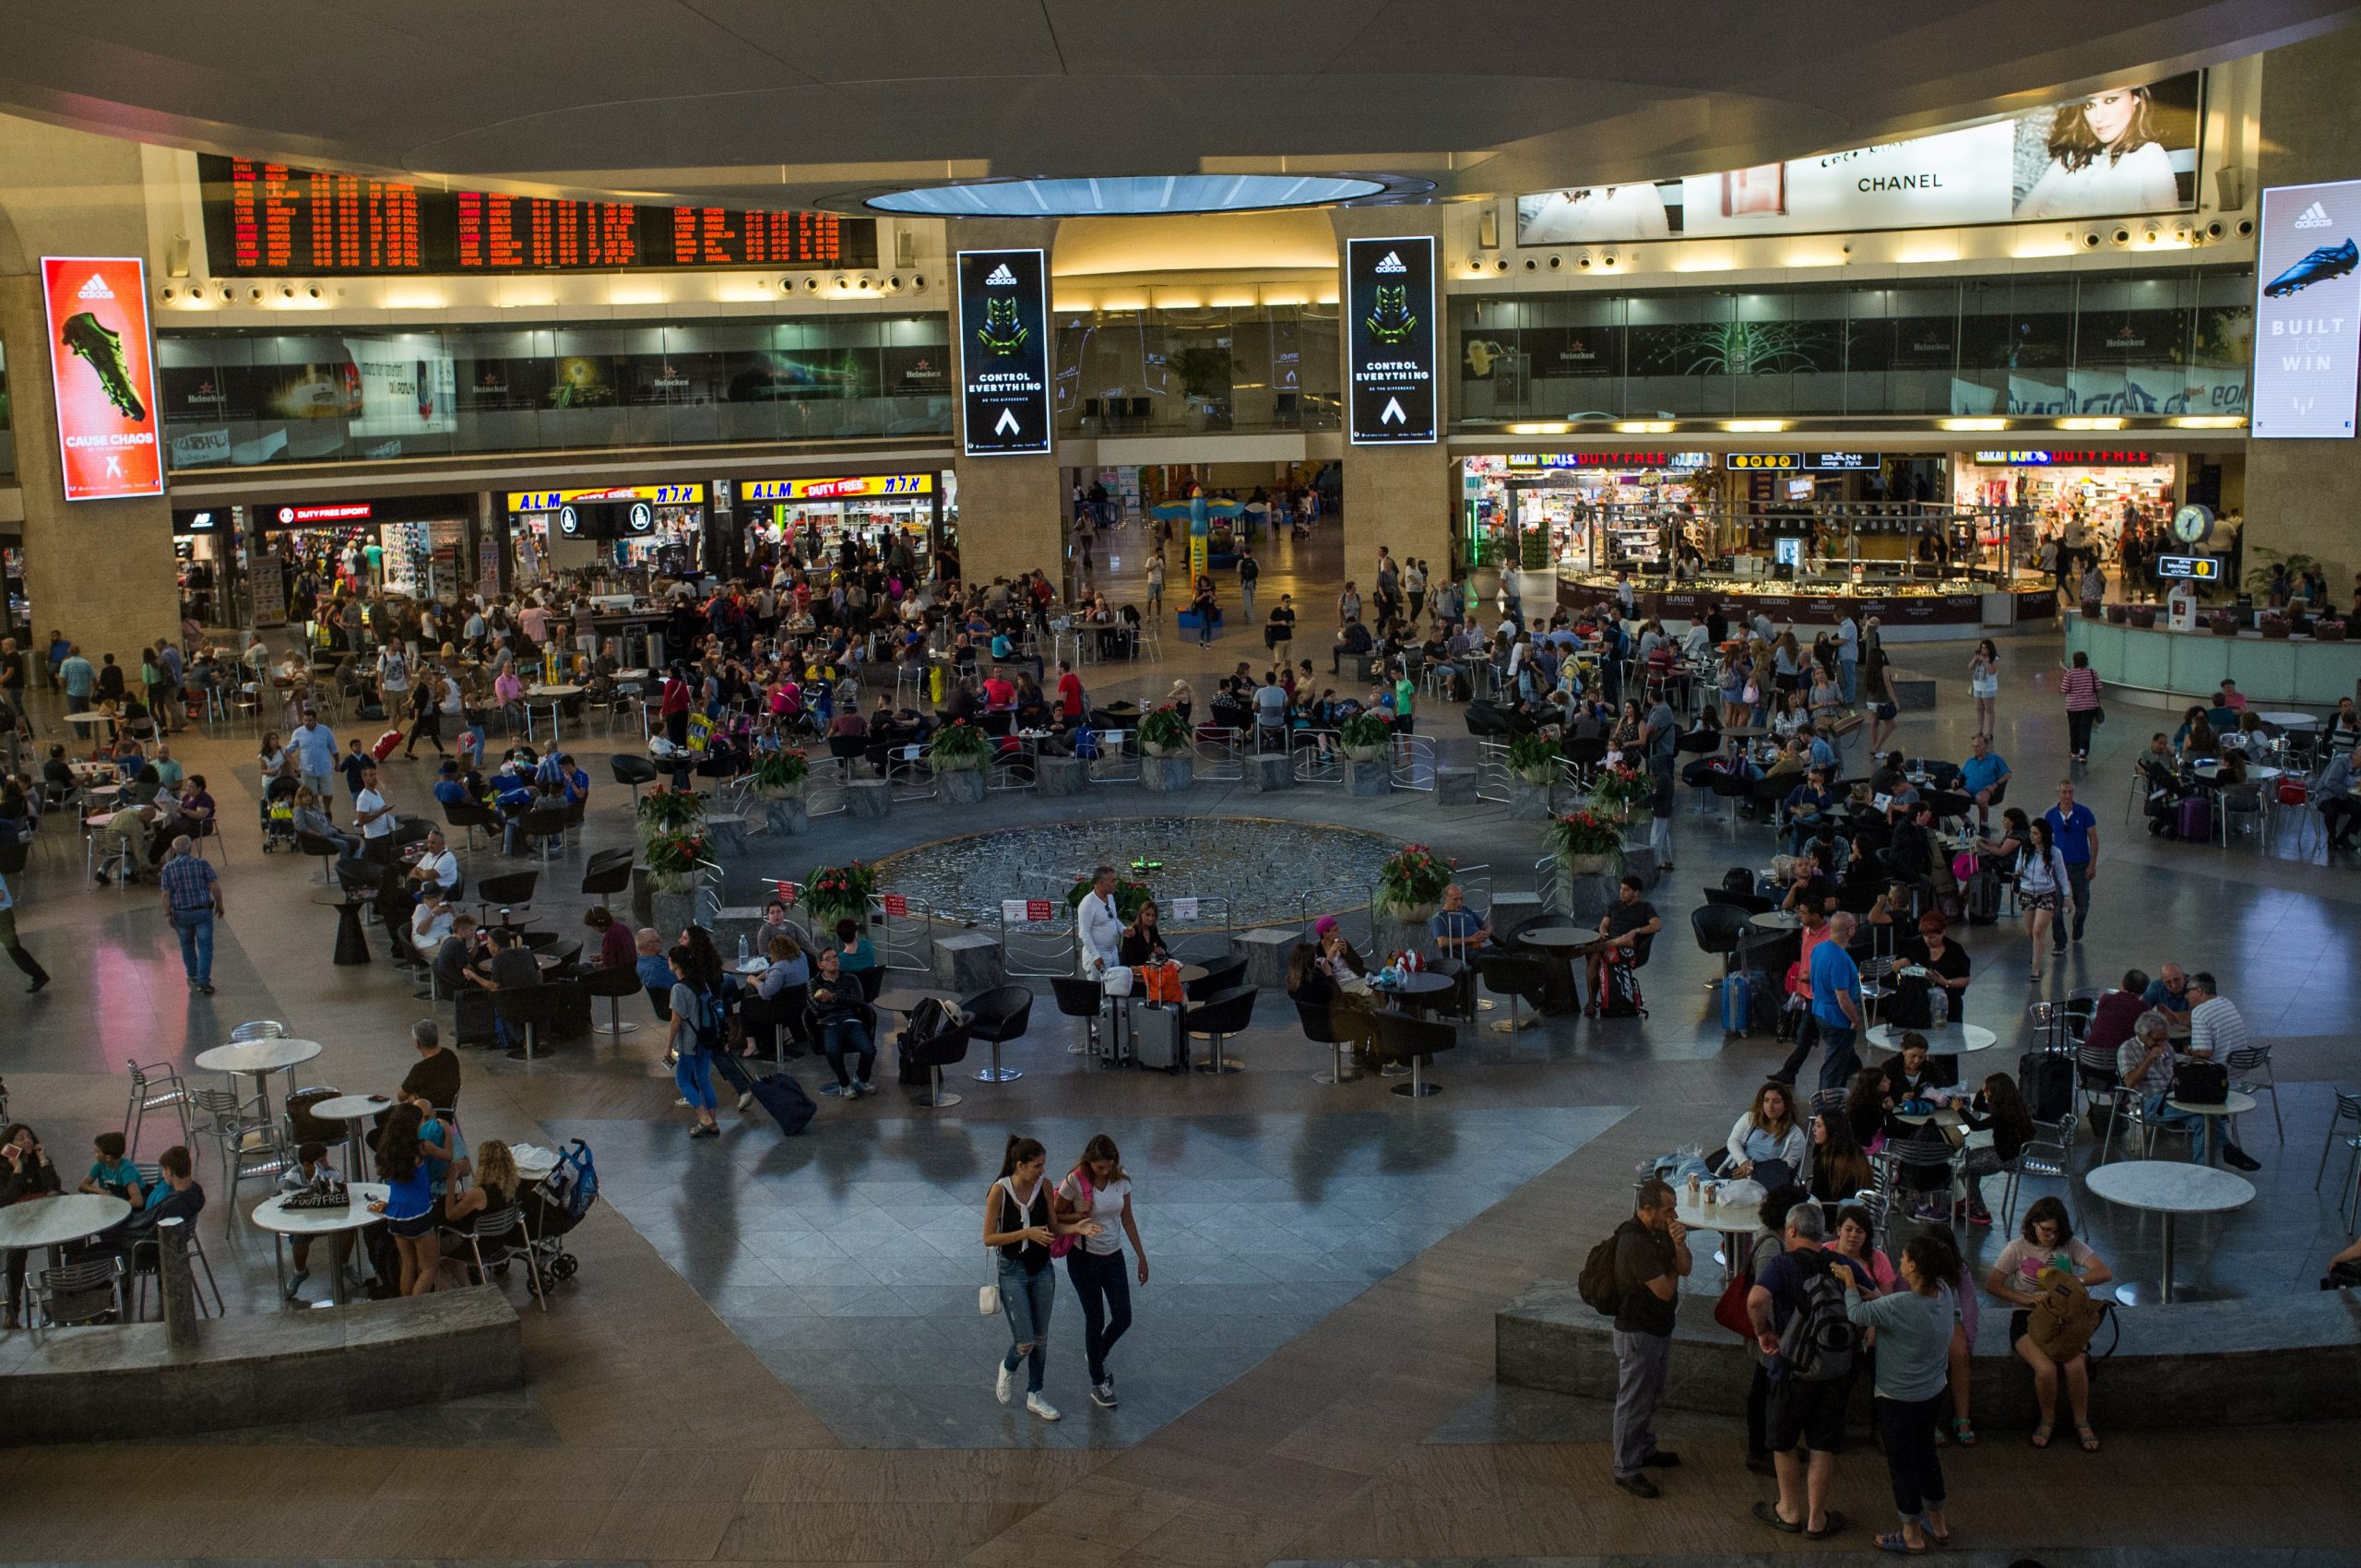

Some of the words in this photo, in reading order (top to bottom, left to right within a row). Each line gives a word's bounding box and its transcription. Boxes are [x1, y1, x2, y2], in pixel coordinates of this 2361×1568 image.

[1858, 173, 1943, 193] CHANEL
[2295, 217, 2332, 229] adidas
[1375, 265, 1406, 273] adidas
[986, 277, 1017, 285] adidas
[77, 290, 114, 299] adidas
[2272, 318, 2344, 336] BUILT
[2106, 339, 2145, 348] Heineken
[2293, 337, 2322, 353] TO
[1560, 351, 1596, 360] Heineken
[1367, 362, 1418, 371] CONTROL
[2283, 355, 2331, 371] WIN
[979, 373, 1030, 382] CONTROL
[1356, 372, 1430, 381] EVERYTHING
[968, 384, 1041, 393] EVERYTHING
[66, 434, 107, 447] CAUSE
[110, 433, 154, 445] CHAOS
[1579, 453, 1619, 464] DUTY
[1624, 452, 1666, 464] FREE
[2010, 451, 2047, 461] KIDS
[808, 483, 835, 496] DUTY
[838, 481, 864, 492] FREE
[297, 510, 320, 518] DUTY
[320, 508, 339, 517] FREE
[340, 507, 369, 516] SPORT
[1666, 595, 1694, 603] RADO
[323, 1194, 348, 1206] FREE
